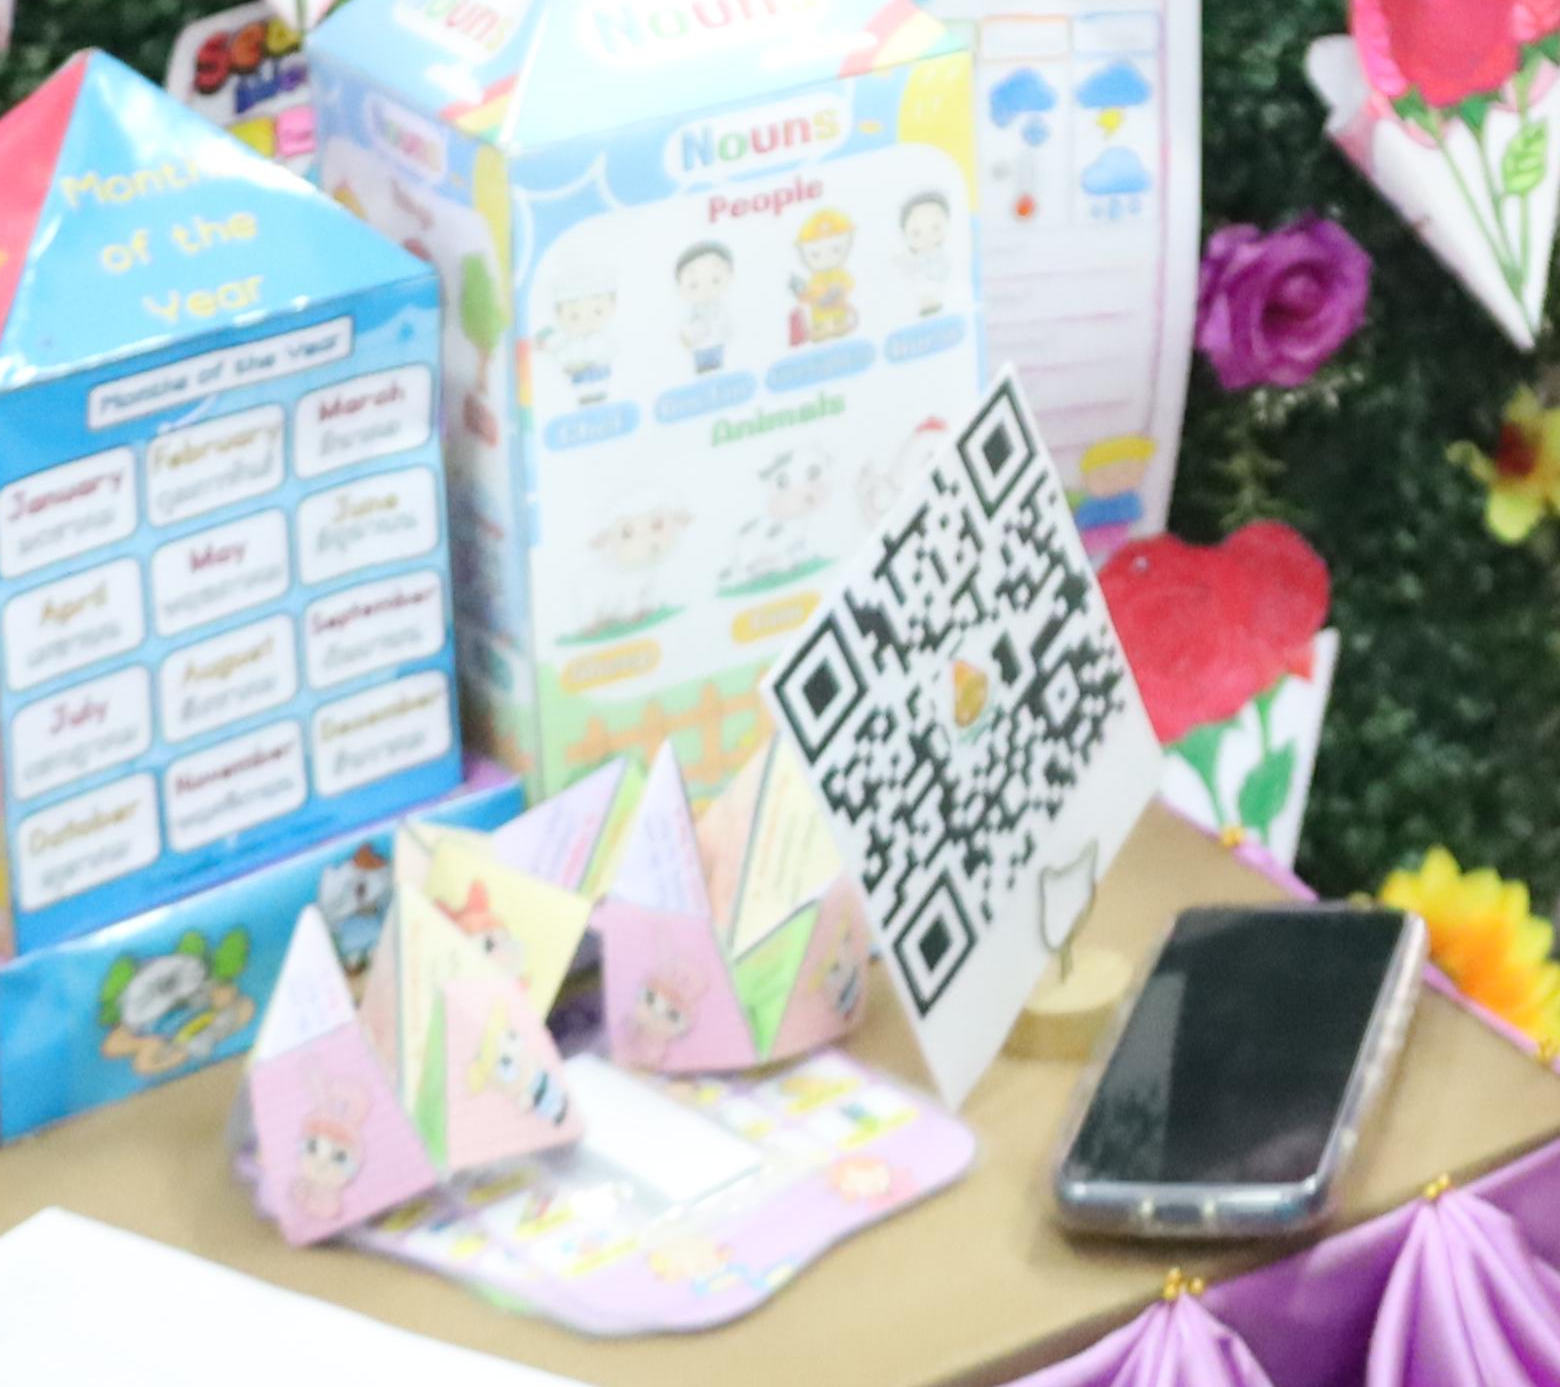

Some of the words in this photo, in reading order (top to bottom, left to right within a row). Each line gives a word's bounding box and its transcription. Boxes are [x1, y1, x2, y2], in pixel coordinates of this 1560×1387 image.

[680, 107, 842, 172] Nouns
[707, 175, 824, 224] People
[100, 229, 153, 274] of
[171, 211, 258, 255] the
[142, 274, 266, 323] Year
[711, 392, 846, 447] Animals
[151, 426, 281, 474] February
[8, 469, 123, 522] January
[334, 491, 400, 526] June
[188, 537, 248, 575] May
[42, 579, 108, 625] April
[50, 697, 108, 735] July
